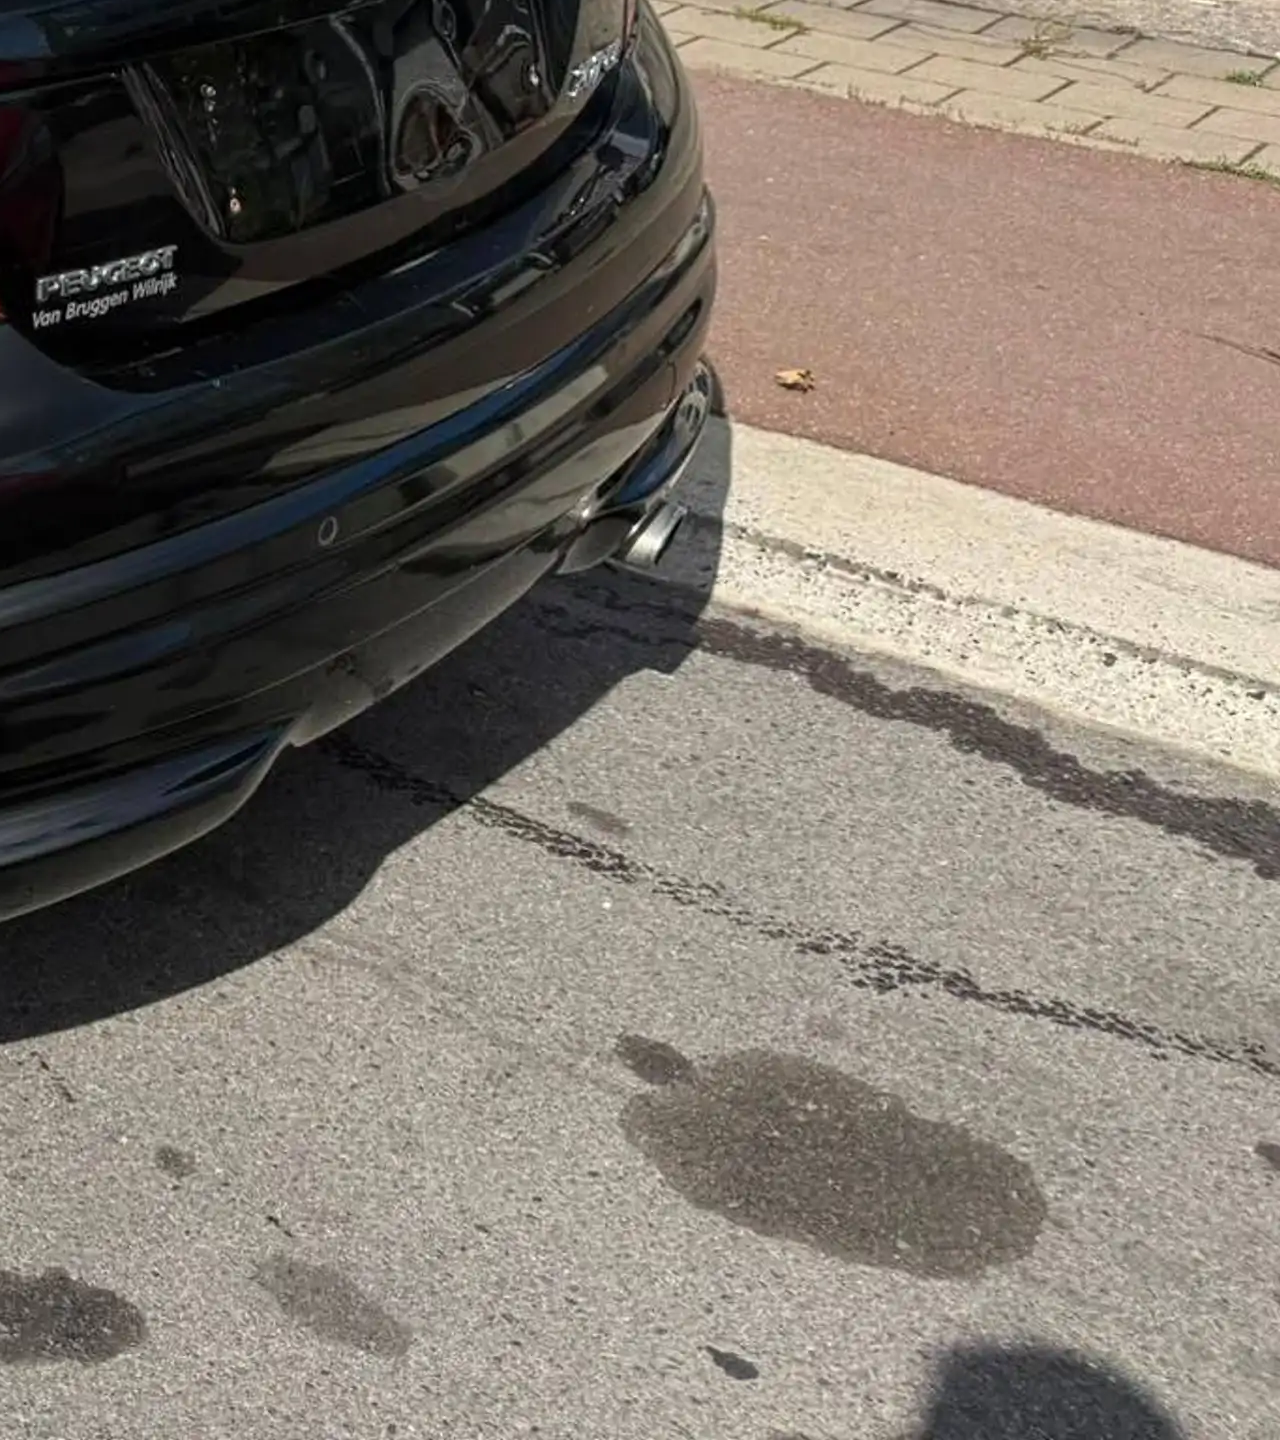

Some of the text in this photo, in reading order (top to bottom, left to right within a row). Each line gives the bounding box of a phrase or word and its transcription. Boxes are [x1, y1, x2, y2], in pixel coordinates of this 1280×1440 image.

[35, 244, 178, 302] PEUGEOT
[32, 310, 61, 329] Van
[65, 289, 129, 320] Bruggen
